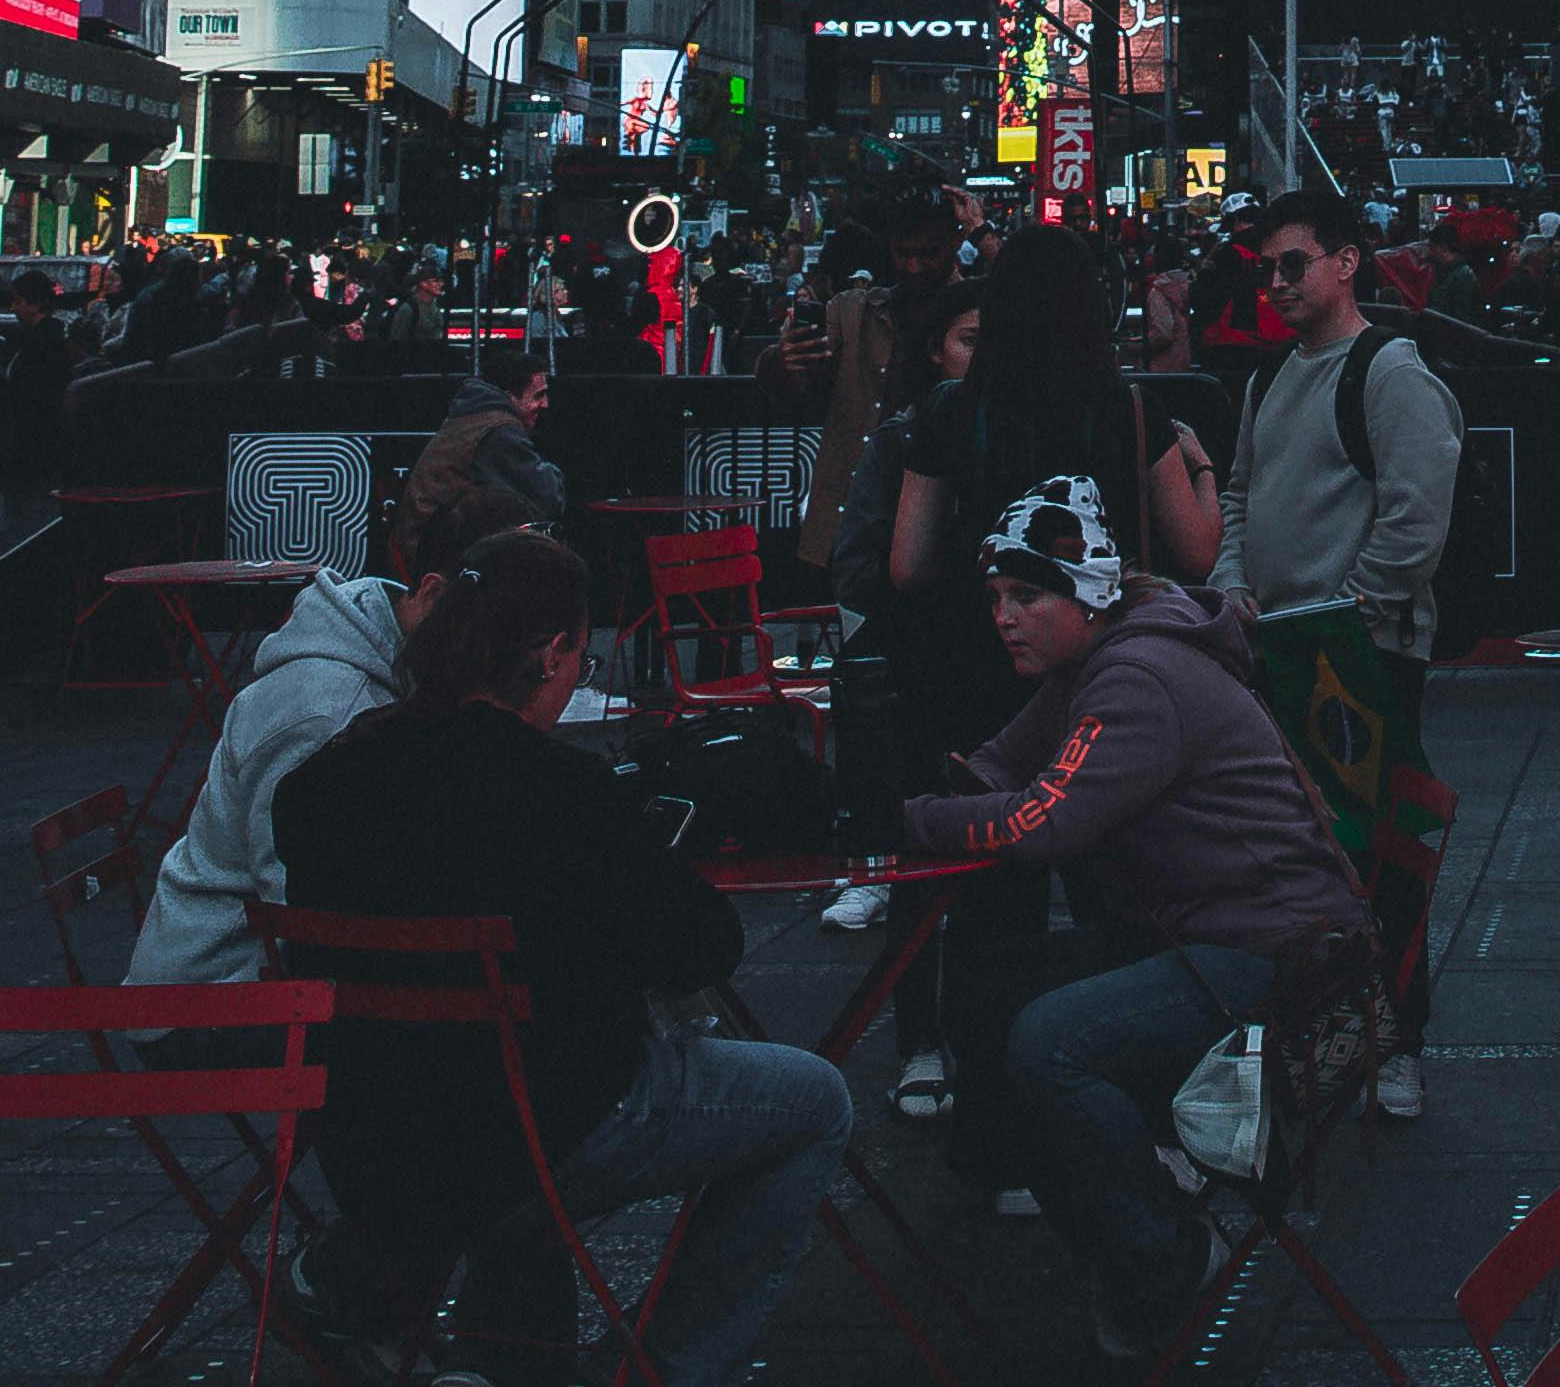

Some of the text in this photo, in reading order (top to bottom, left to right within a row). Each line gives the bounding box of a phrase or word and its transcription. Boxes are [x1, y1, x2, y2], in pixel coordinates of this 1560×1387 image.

[180, 14, 239, 34] OUR TOWN
[1052, 105, 1095, 192] tkts
